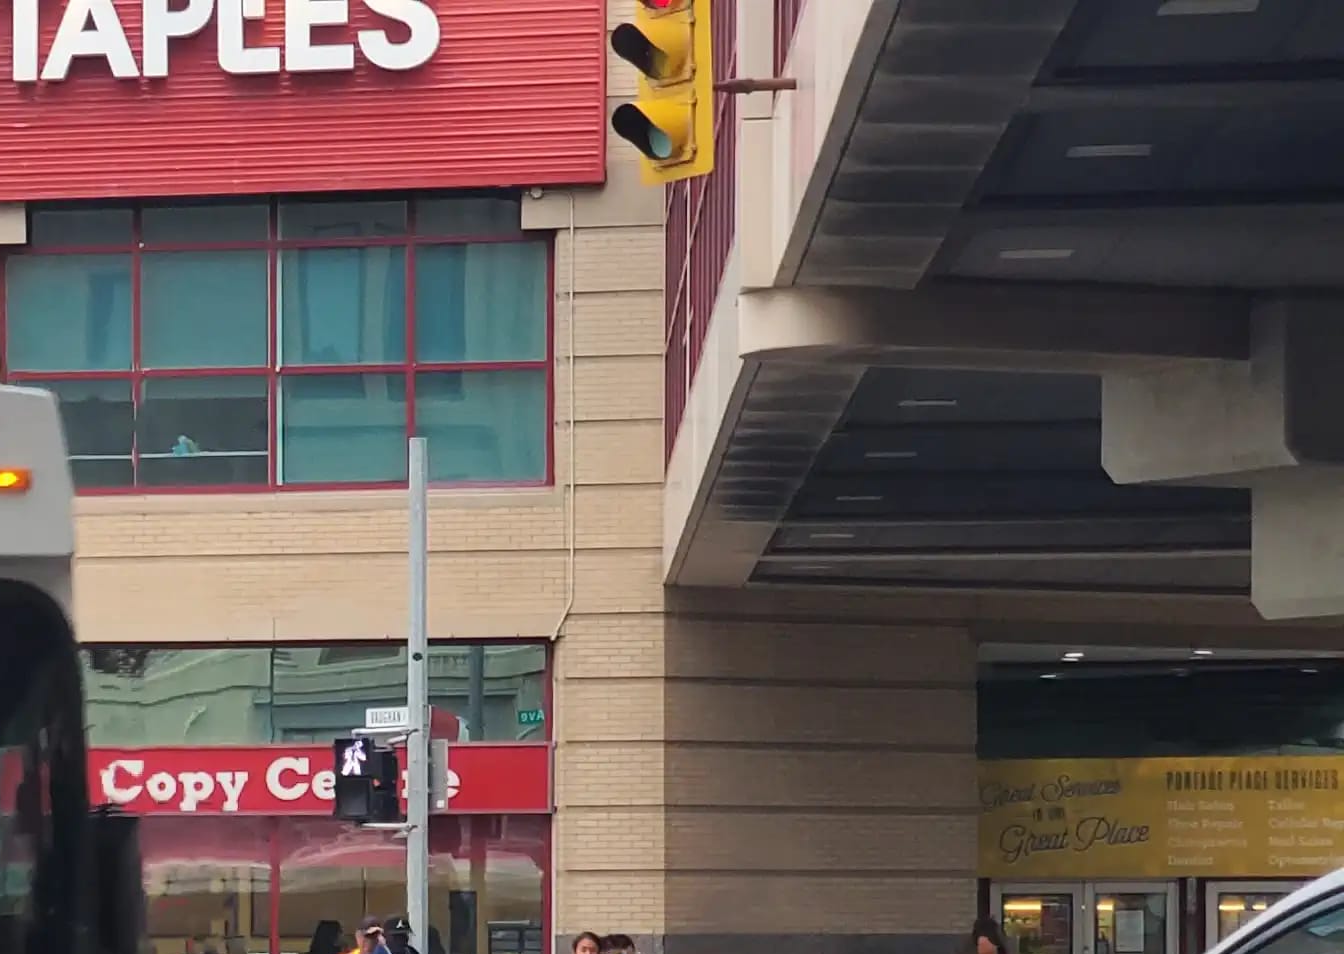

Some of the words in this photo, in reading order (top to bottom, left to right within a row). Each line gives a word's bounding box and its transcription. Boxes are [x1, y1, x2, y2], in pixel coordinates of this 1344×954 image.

[101, 760, 249, 812] Copy
[1000, 824, 1070, 864] Great
[1075, 816, 1150, 853] Place
